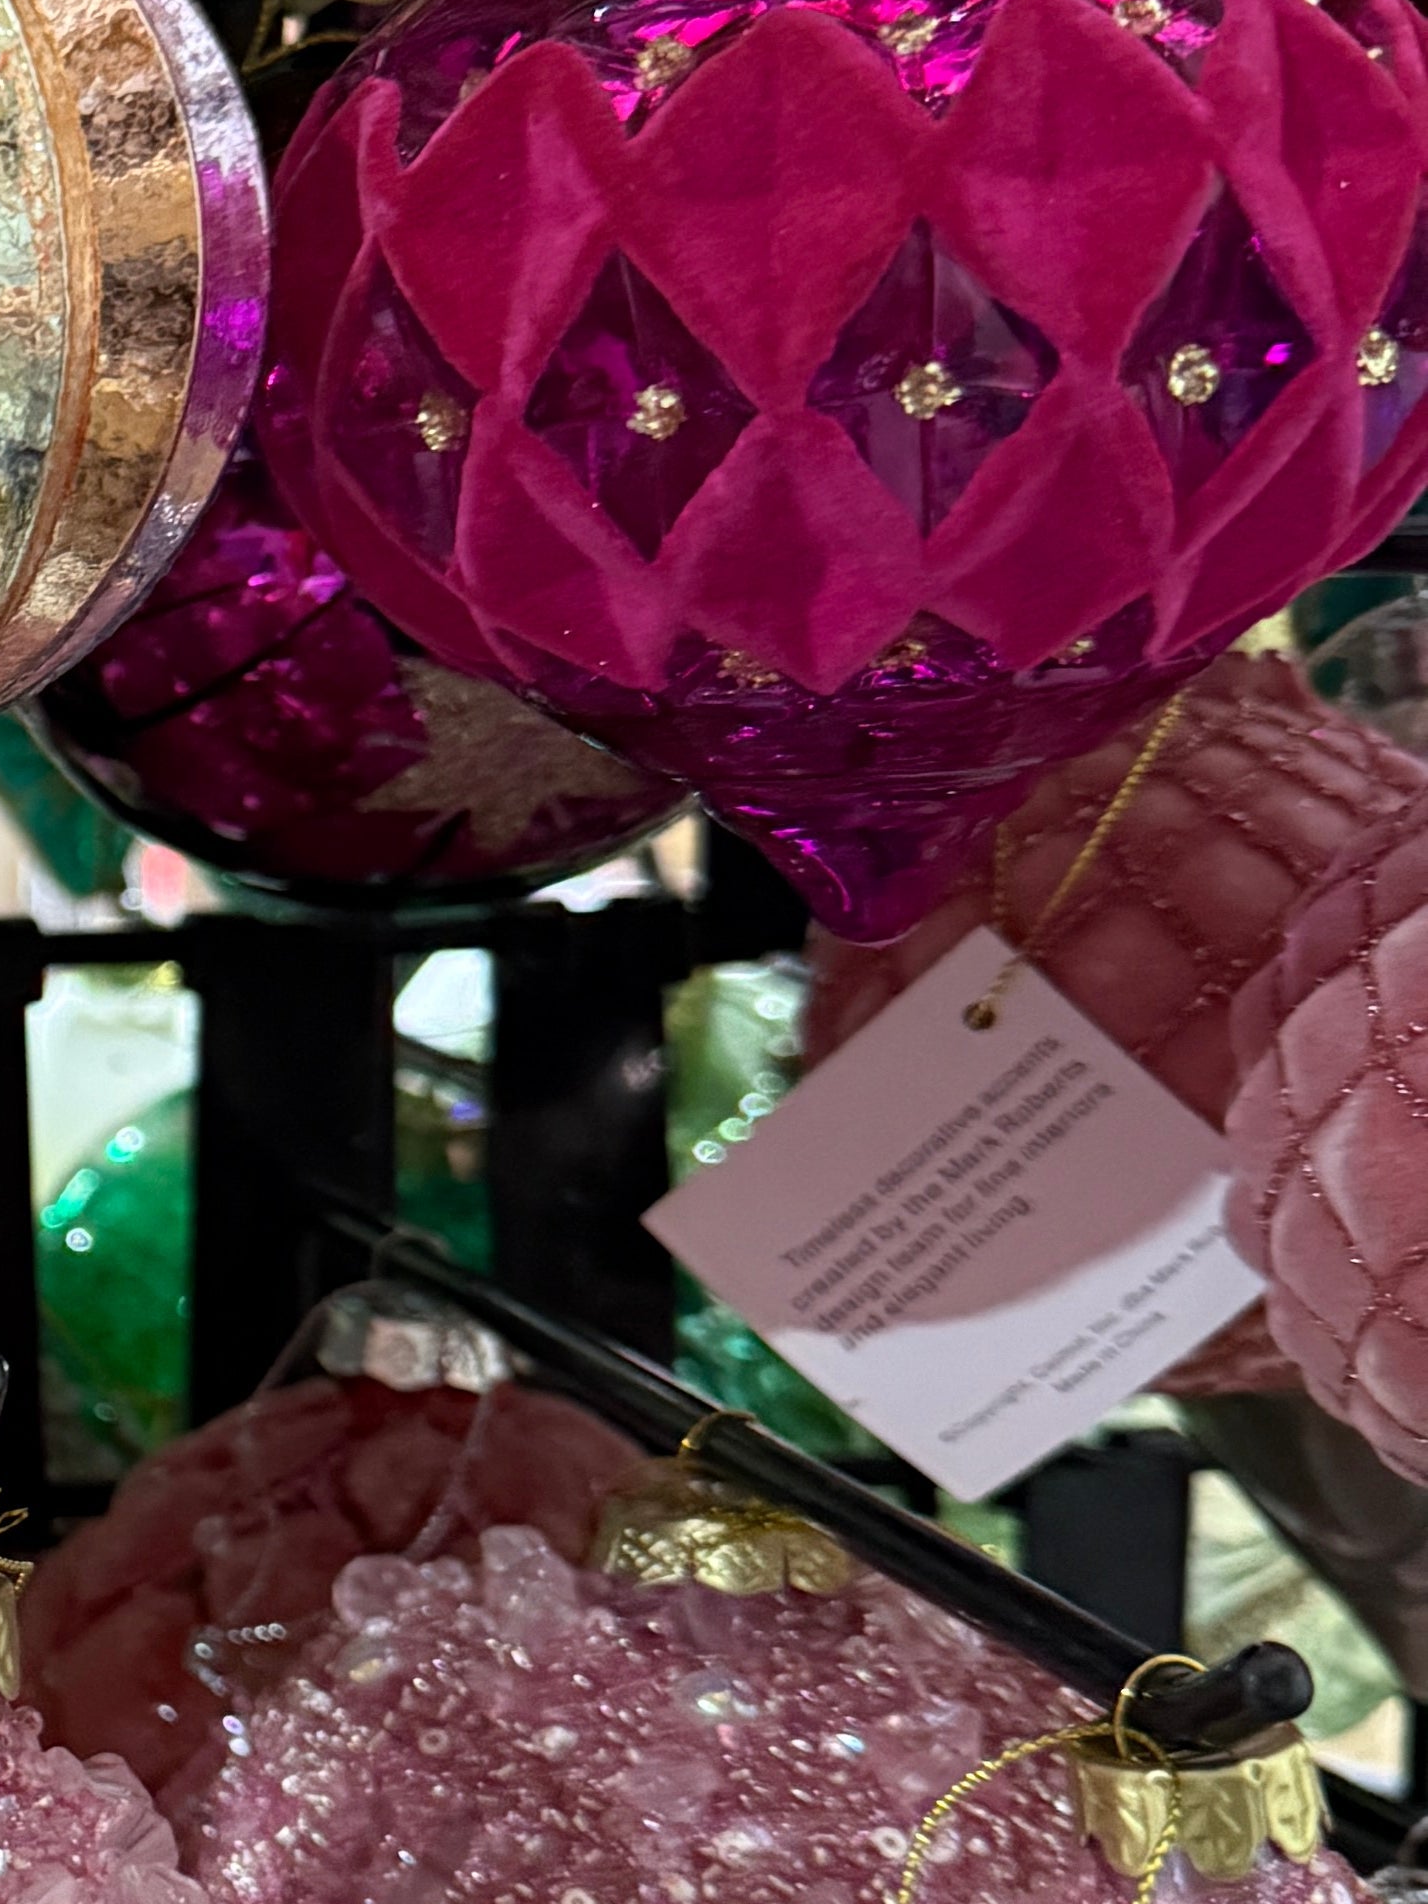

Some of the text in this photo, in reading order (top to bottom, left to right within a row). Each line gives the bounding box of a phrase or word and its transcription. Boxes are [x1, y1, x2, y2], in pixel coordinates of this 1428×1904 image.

[779, 1037, 1062, 1267] Timeless decorative accents
[792, 1059, 1088, 1313] created by the Mark Roberts
[814, 1082, 1115, 1333] design team for fine interiors
[839, 1313, 886, 1352] and
[884, 1245, 970, 1316] elegant
